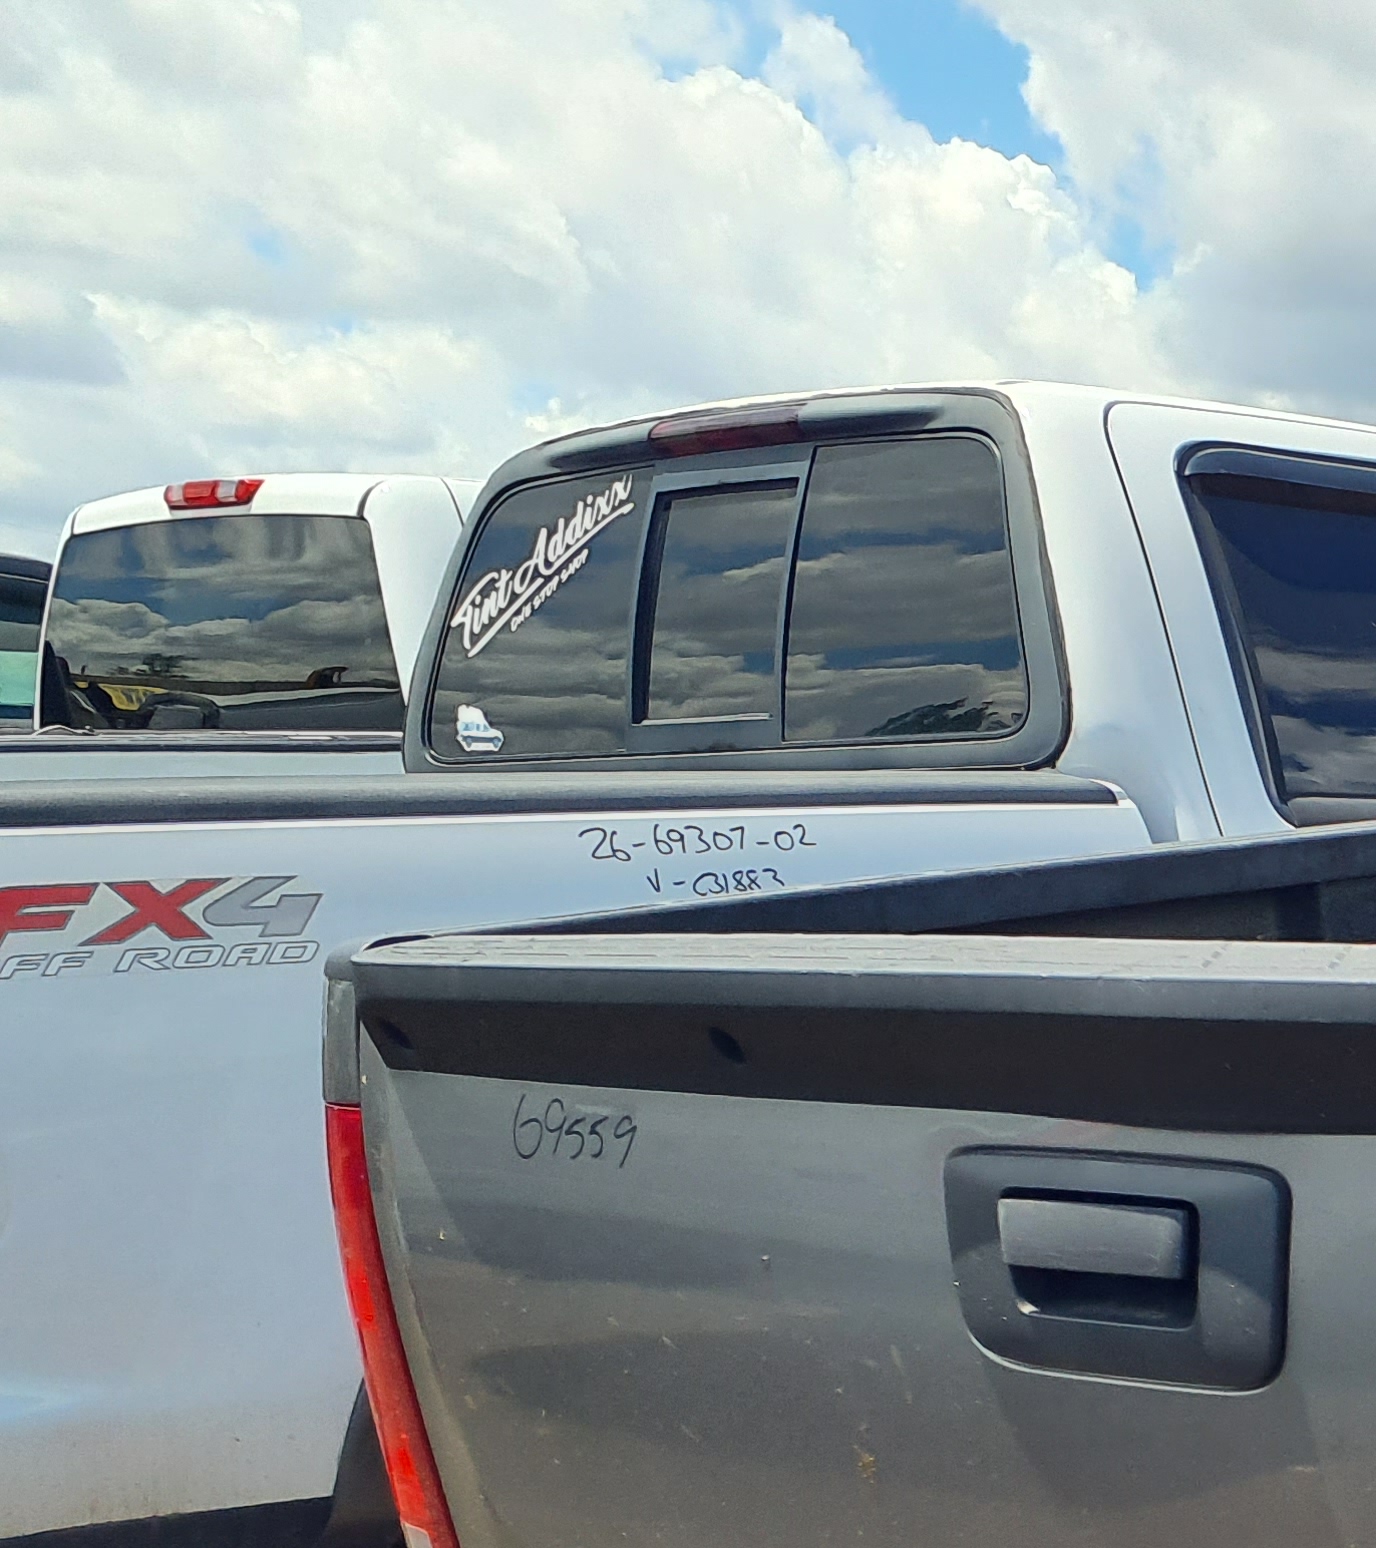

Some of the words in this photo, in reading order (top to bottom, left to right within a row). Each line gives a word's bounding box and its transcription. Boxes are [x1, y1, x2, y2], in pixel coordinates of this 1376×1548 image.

[449, 568, 513, 650] Tint
[513, 473, 633, 595] Addixx
[577, 823, 817, 862] 26-69307-02
[0, 875, 323, 947] FX4
[0, 950, 94, 980] FF
[113, 940, 320, 973] ROAD
[512, 1093, 638, 1169] 69559
